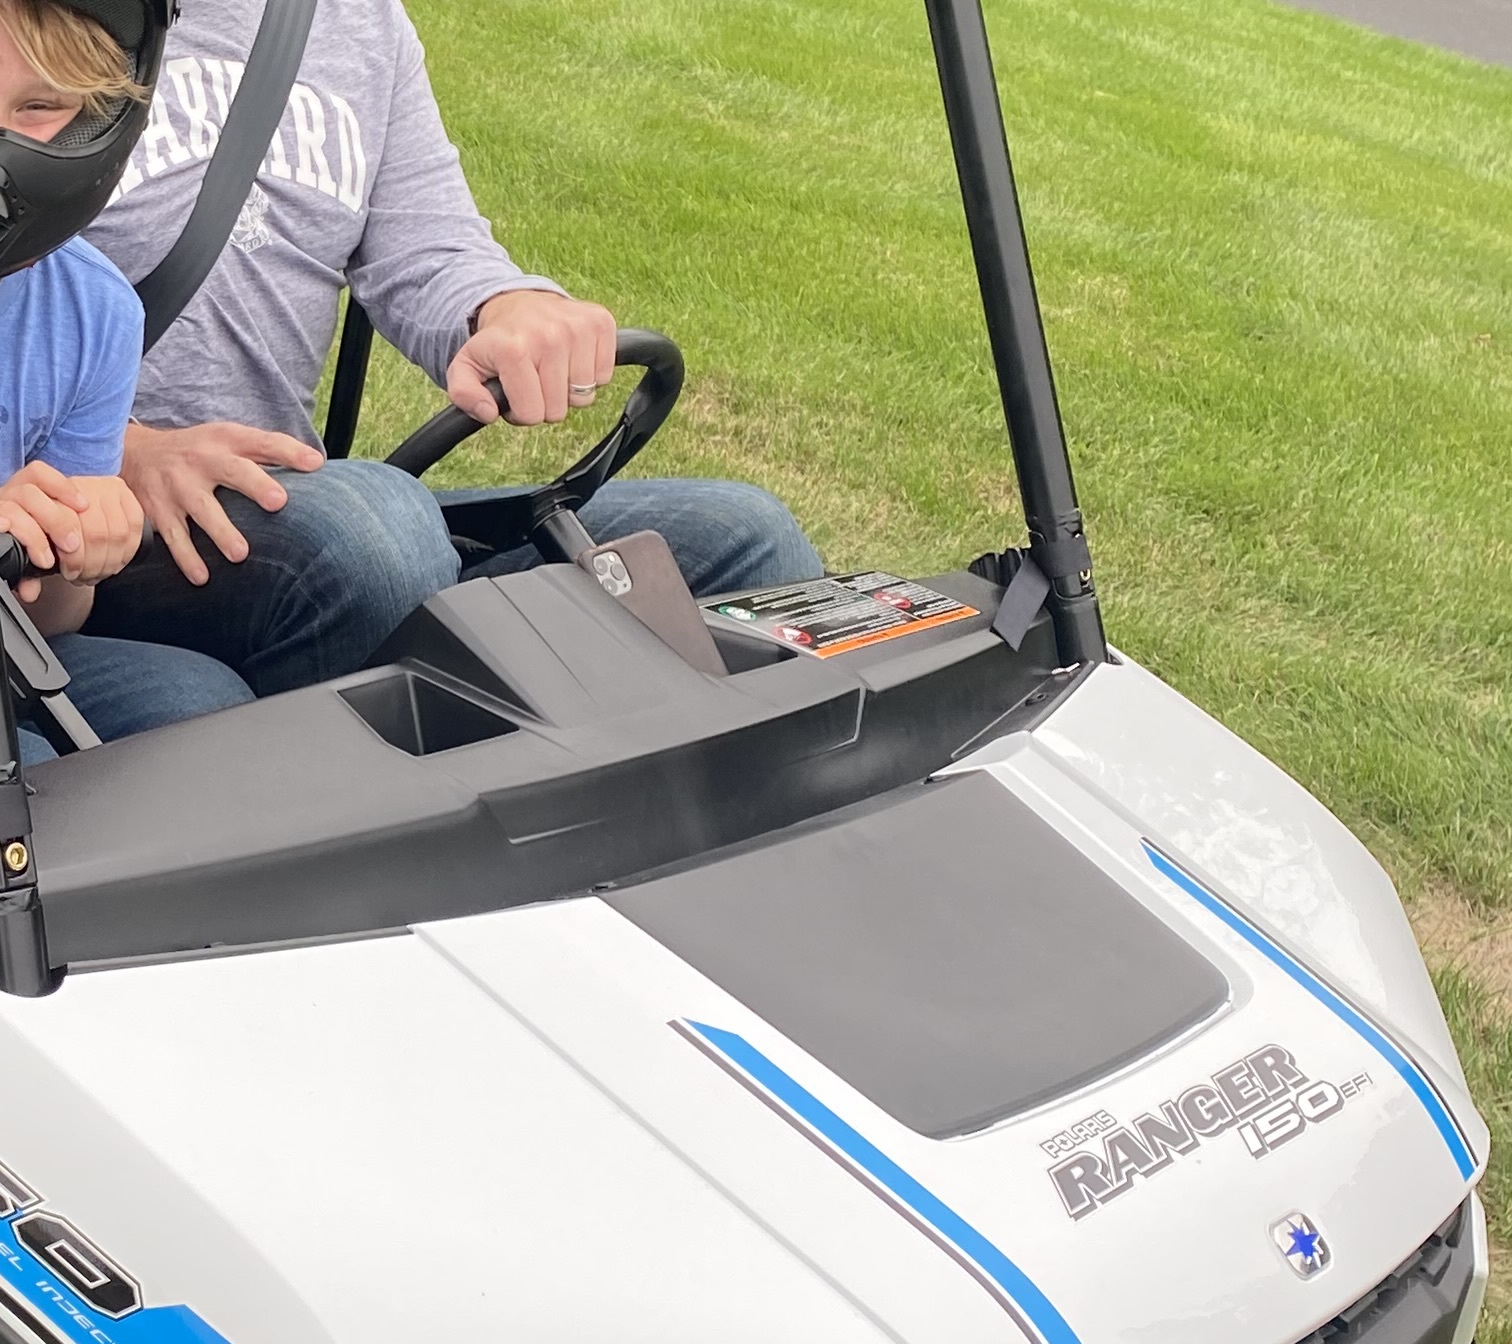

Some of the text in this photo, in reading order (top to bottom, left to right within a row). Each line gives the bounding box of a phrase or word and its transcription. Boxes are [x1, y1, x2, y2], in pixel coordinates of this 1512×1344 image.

[1040, 1109, 1118, 1158] POLARIS
[1047, 1044, 1310, 1221] RANGER
[1237, 1071, 1374, 1160] 150 EFI
